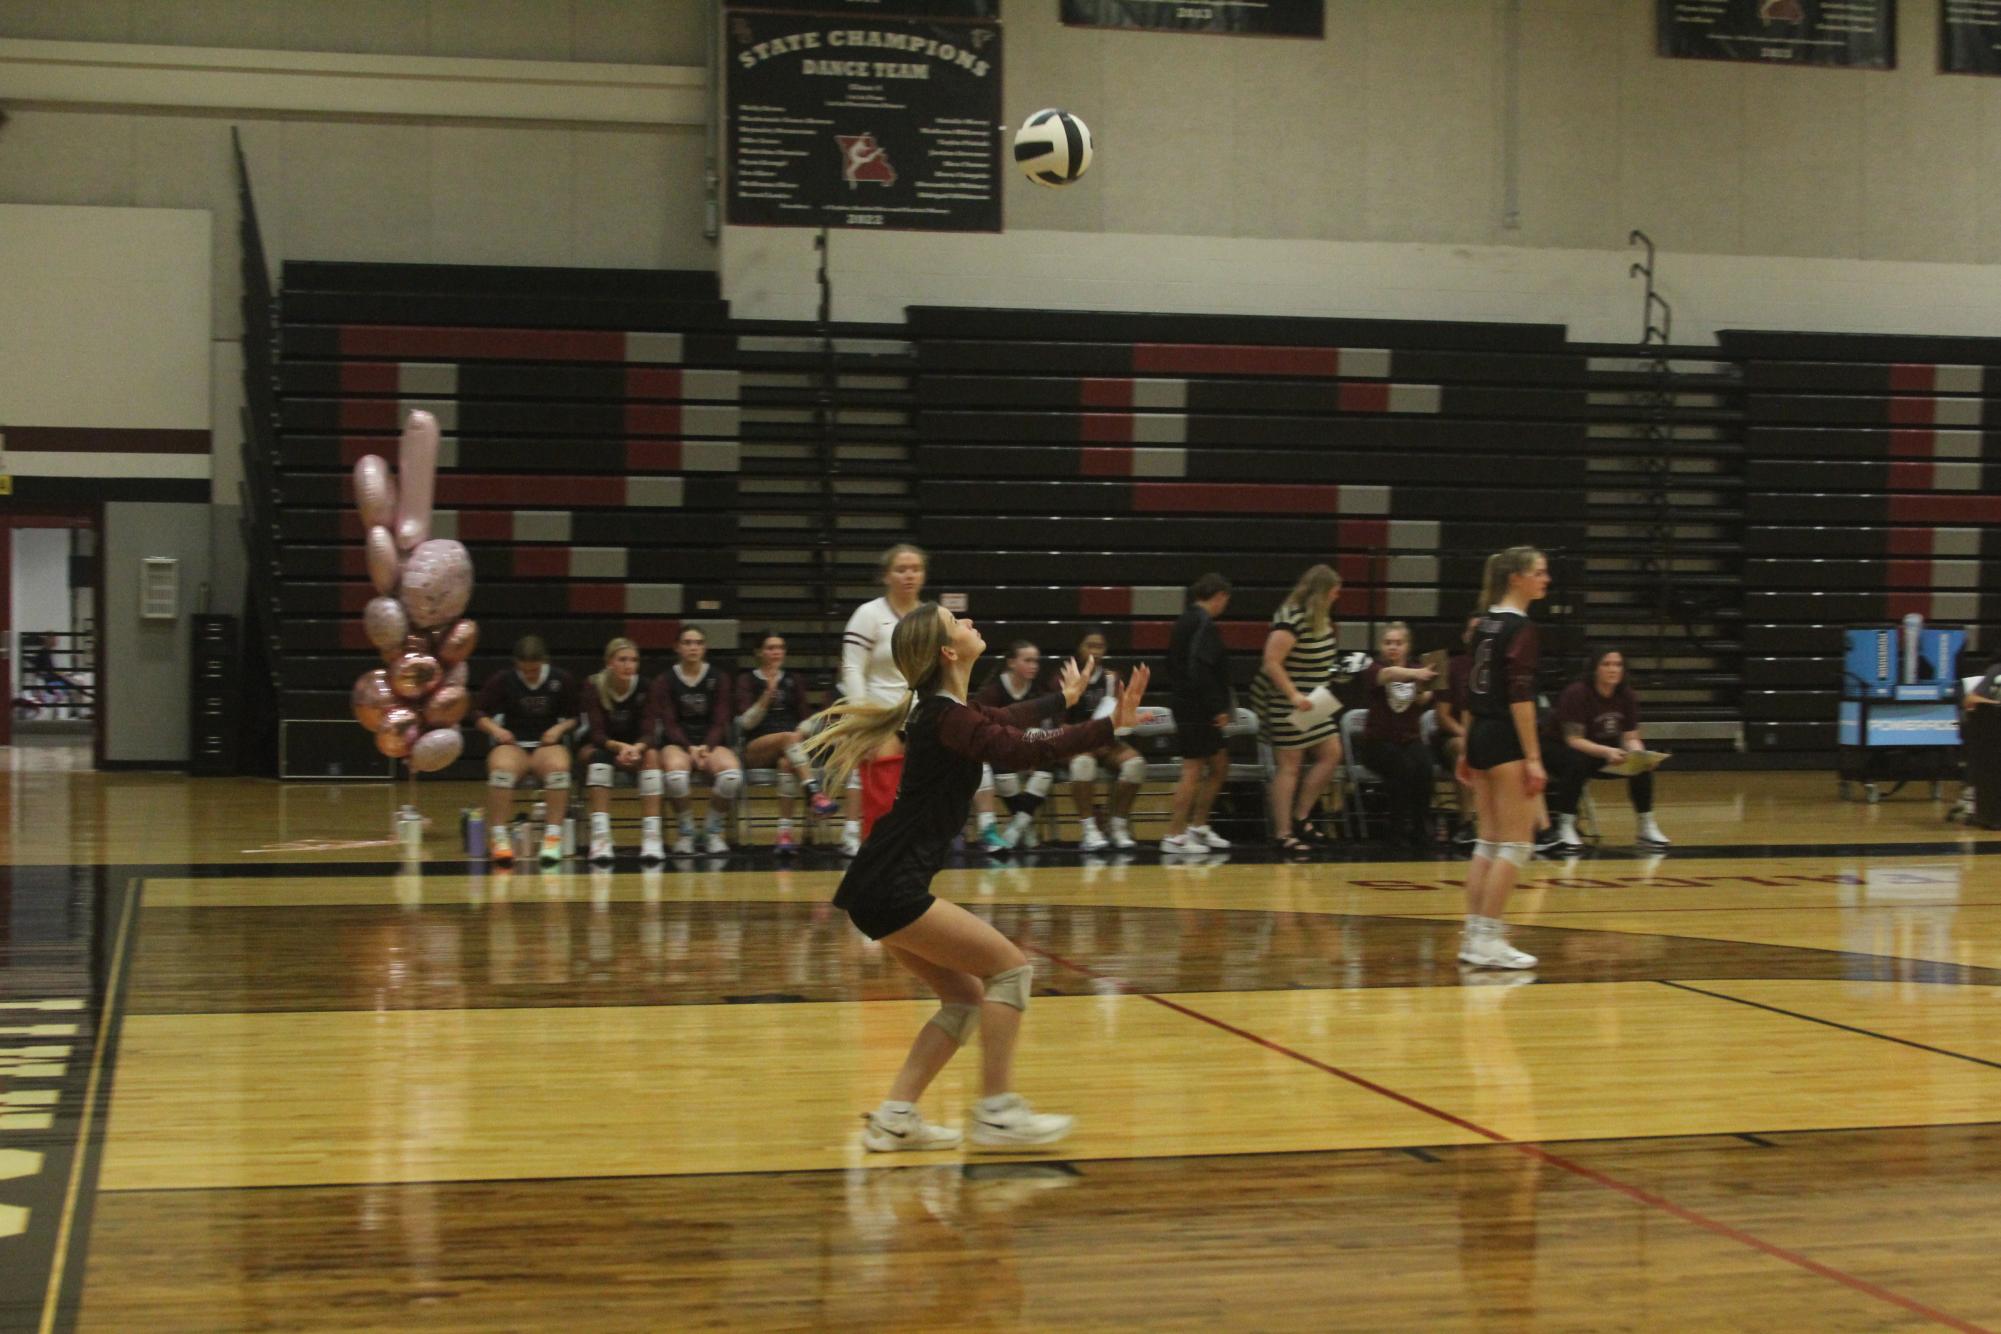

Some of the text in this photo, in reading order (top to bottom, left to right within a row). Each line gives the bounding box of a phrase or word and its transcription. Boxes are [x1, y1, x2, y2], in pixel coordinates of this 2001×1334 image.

[738, 30, 991, 77] STATE CHAMPIONS
[801, 59, 930, 79] DANCE TEAM
